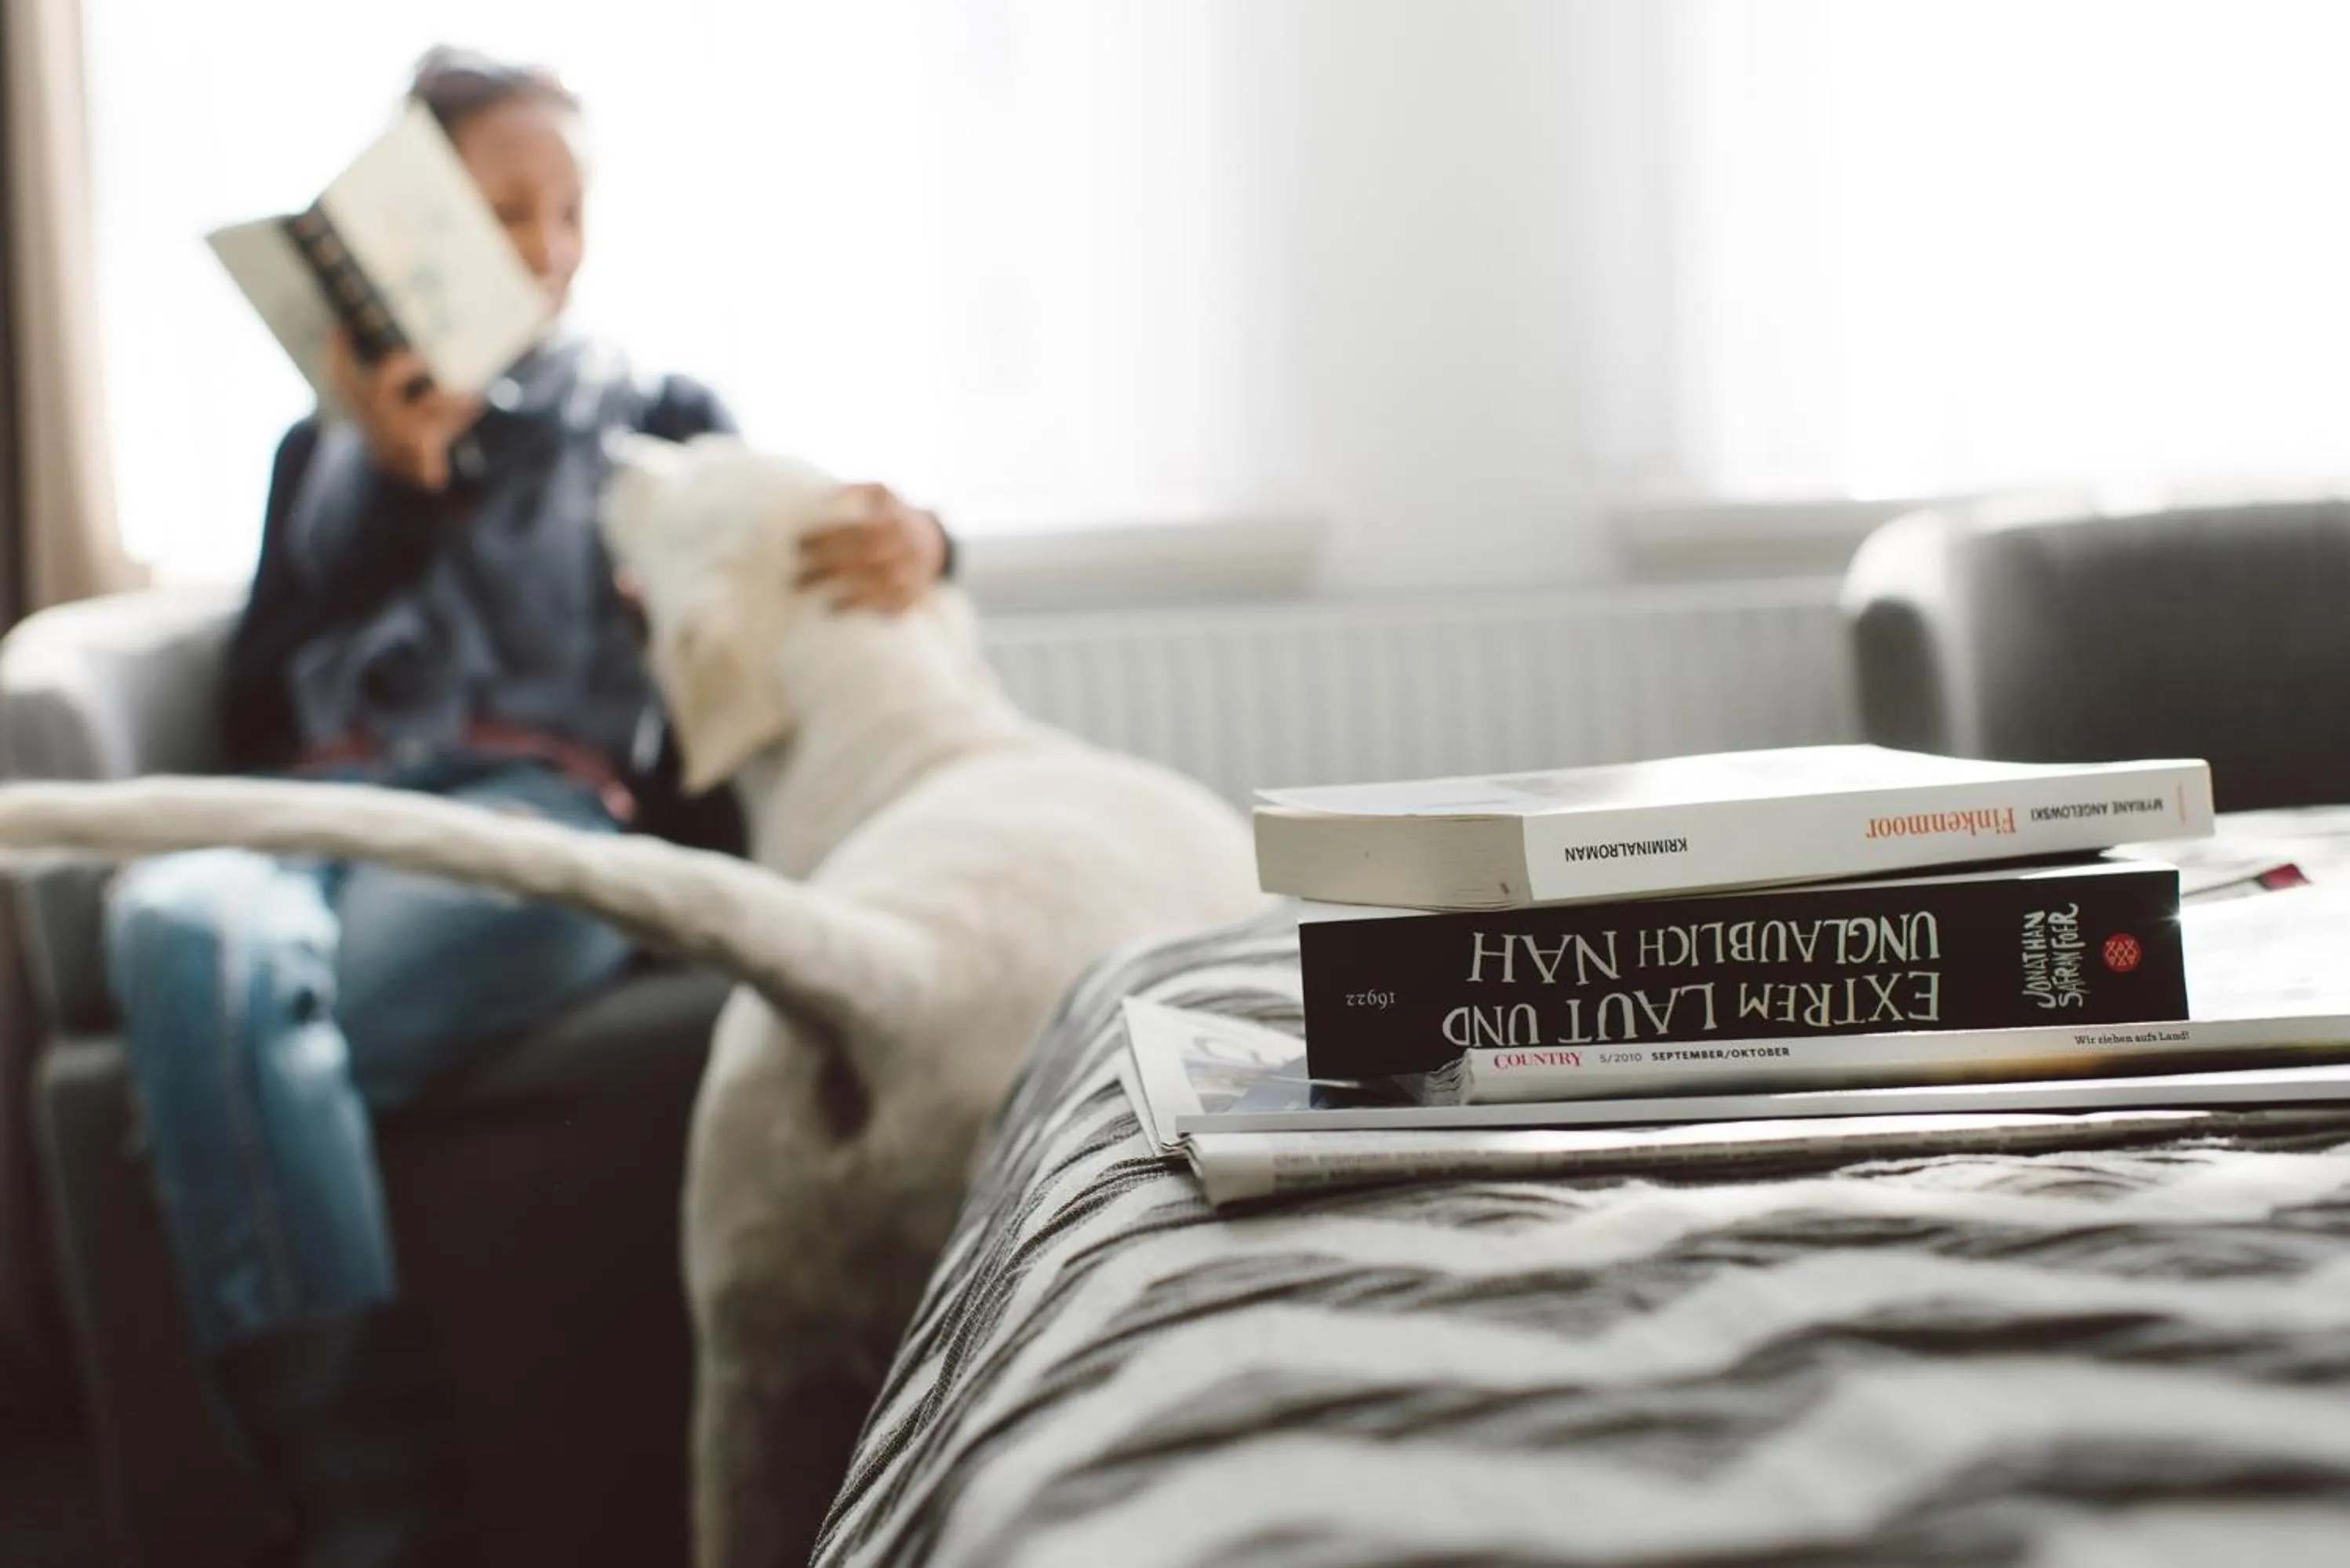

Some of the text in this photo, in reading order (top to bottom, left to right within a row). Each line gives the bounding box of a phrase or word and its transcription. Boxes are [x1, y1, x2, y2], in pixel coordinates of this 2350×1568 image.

[1865, 807, 2017, 839] Finkenmoor
[2030, 799, 2164, 821] MYRIANE ANGELOWSKI
[1565, 838, 1688, 862] KRIMINALROMAN
[1466, 911, 1941, 985] UNGLAUBLICH NAH
[2021, 910, 2057, 1009] JONATHAN
[2048, 903, 2090, 1008] SAFRAN FOER
[1345, 989, 1397, 1010] 16922
[1442, 970, 1941, 1047] EXTREM LAUT UND
[2074, 1030, 2191, 1045] Wir ziehen aufs Land!
[1493, 1046, 1791, 1070] COUNTRY 5/2010 SEPTEMBER/OKTOBER
